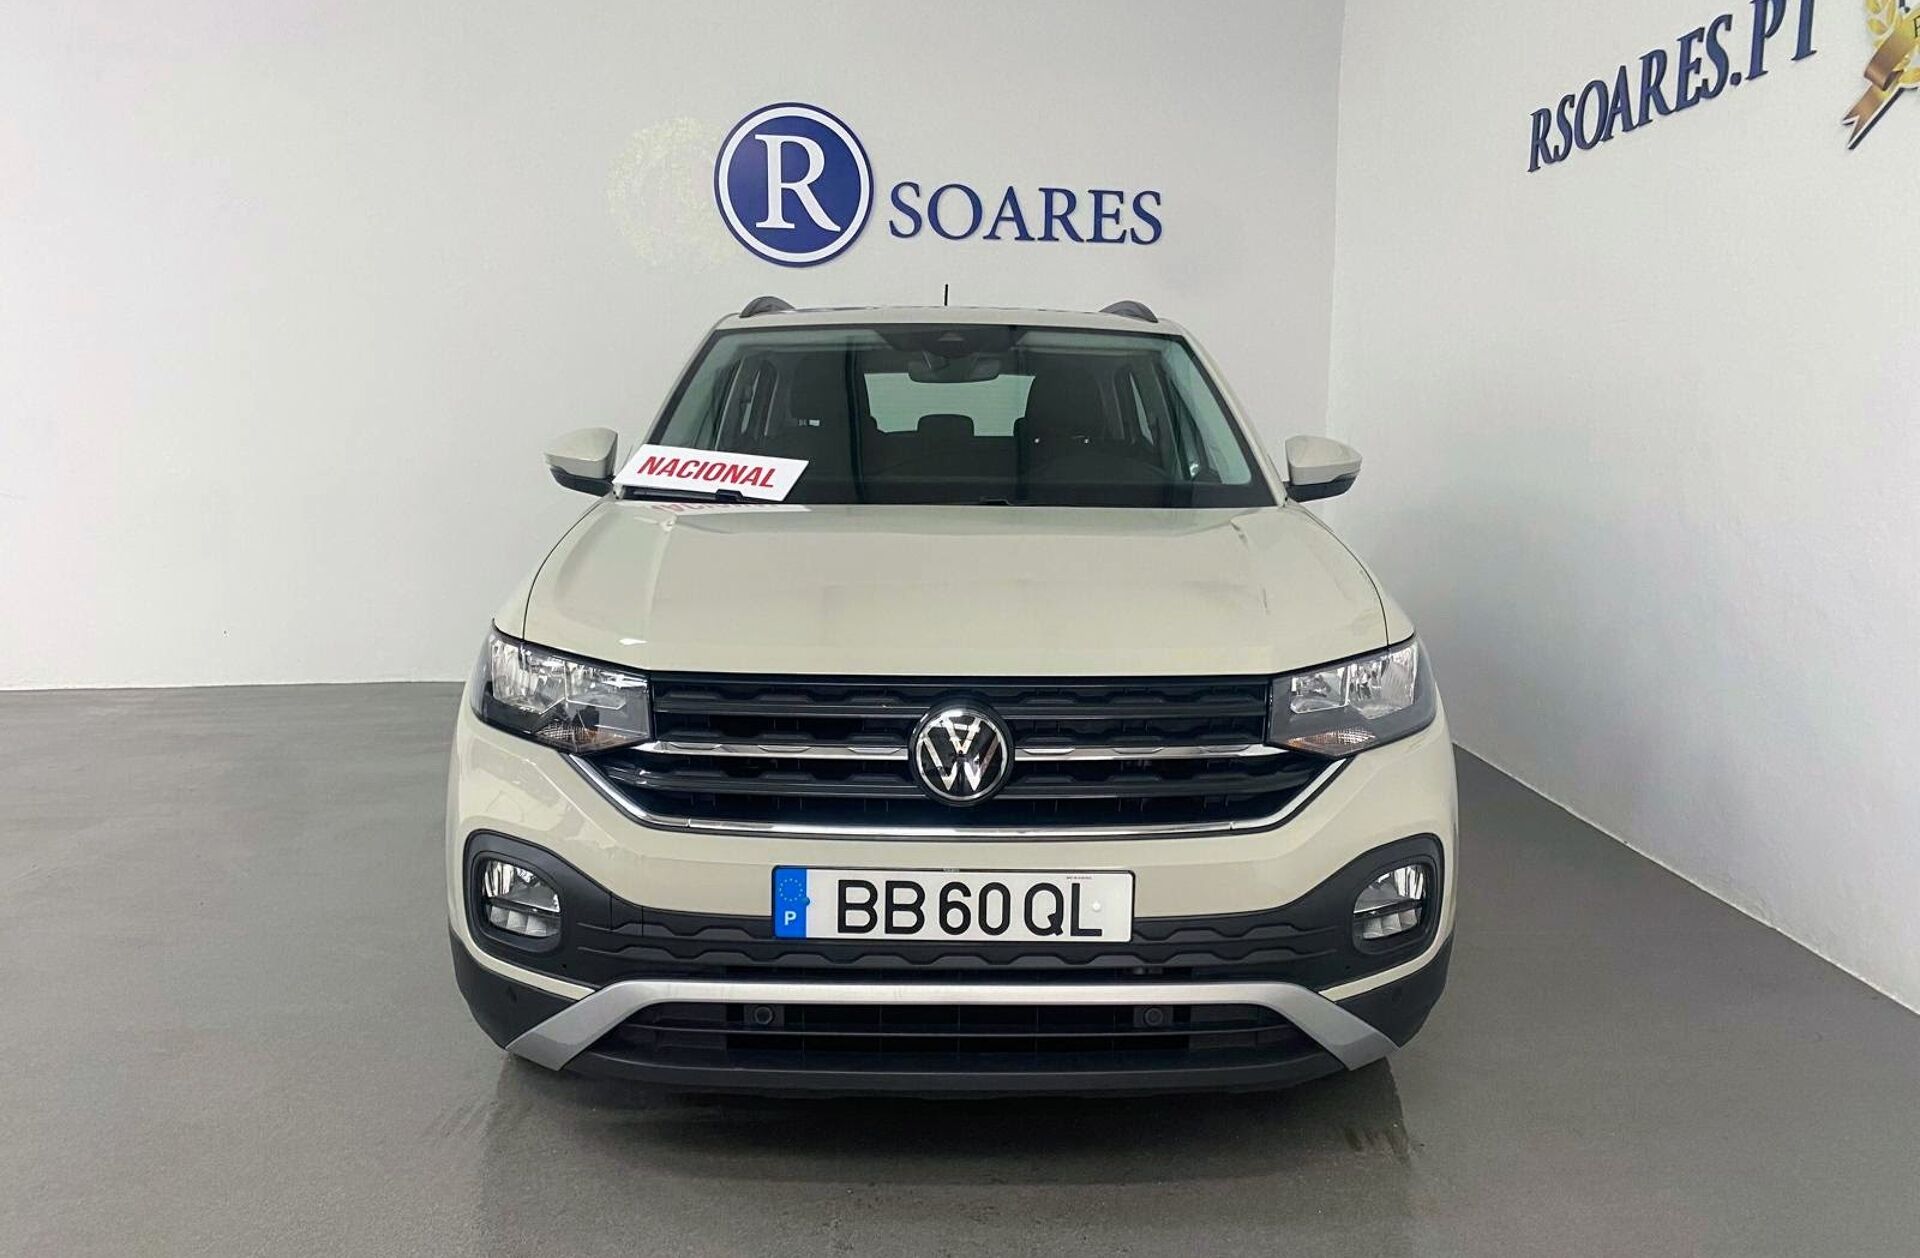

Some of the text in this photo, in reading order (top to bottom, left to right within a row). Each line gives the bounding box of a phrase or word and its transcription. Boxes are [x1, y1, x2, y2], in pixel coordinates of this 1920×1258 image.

[754, 133, 1163, 246] R SOARES
[637, 456, 776, 488] NACIONAL
[922, 716, 1002, 791] VW
[784, 880, 1103, 937] P BB 60 QL
